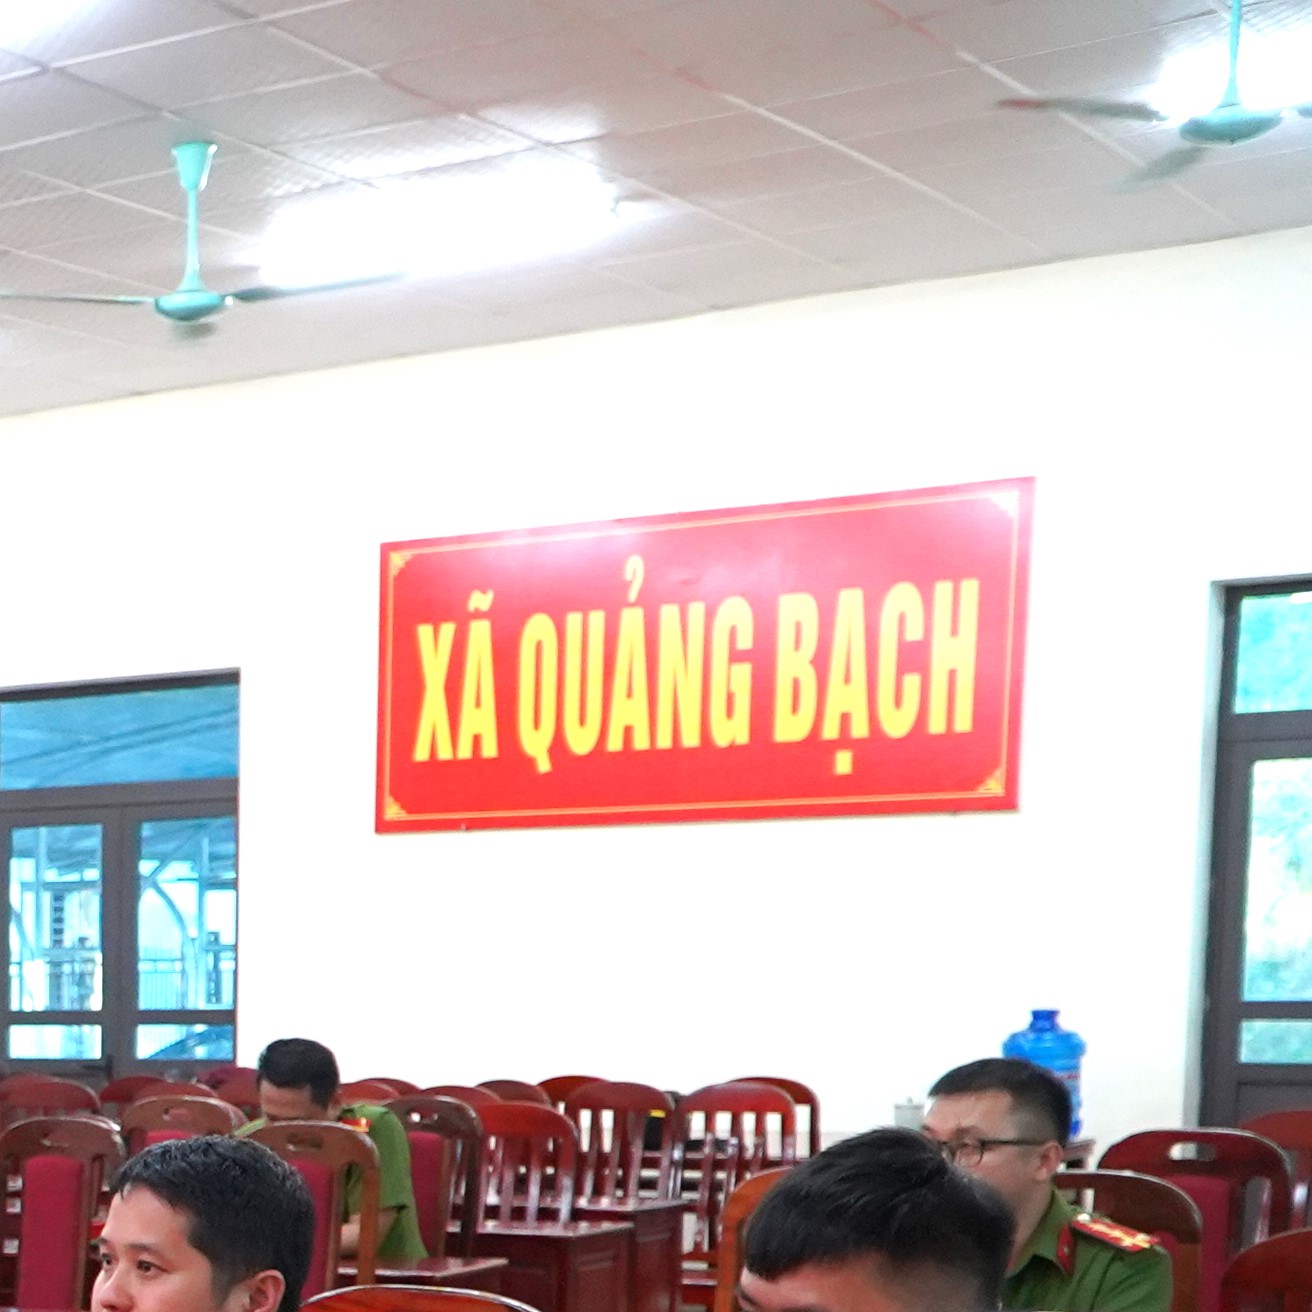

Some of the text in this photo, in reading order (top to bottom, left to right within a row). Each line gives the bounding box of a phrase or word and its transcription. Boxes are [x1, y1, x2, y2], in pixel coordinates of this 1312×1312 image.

[412, 554, 980, 776] XÃ QUẢNG BẠCH
